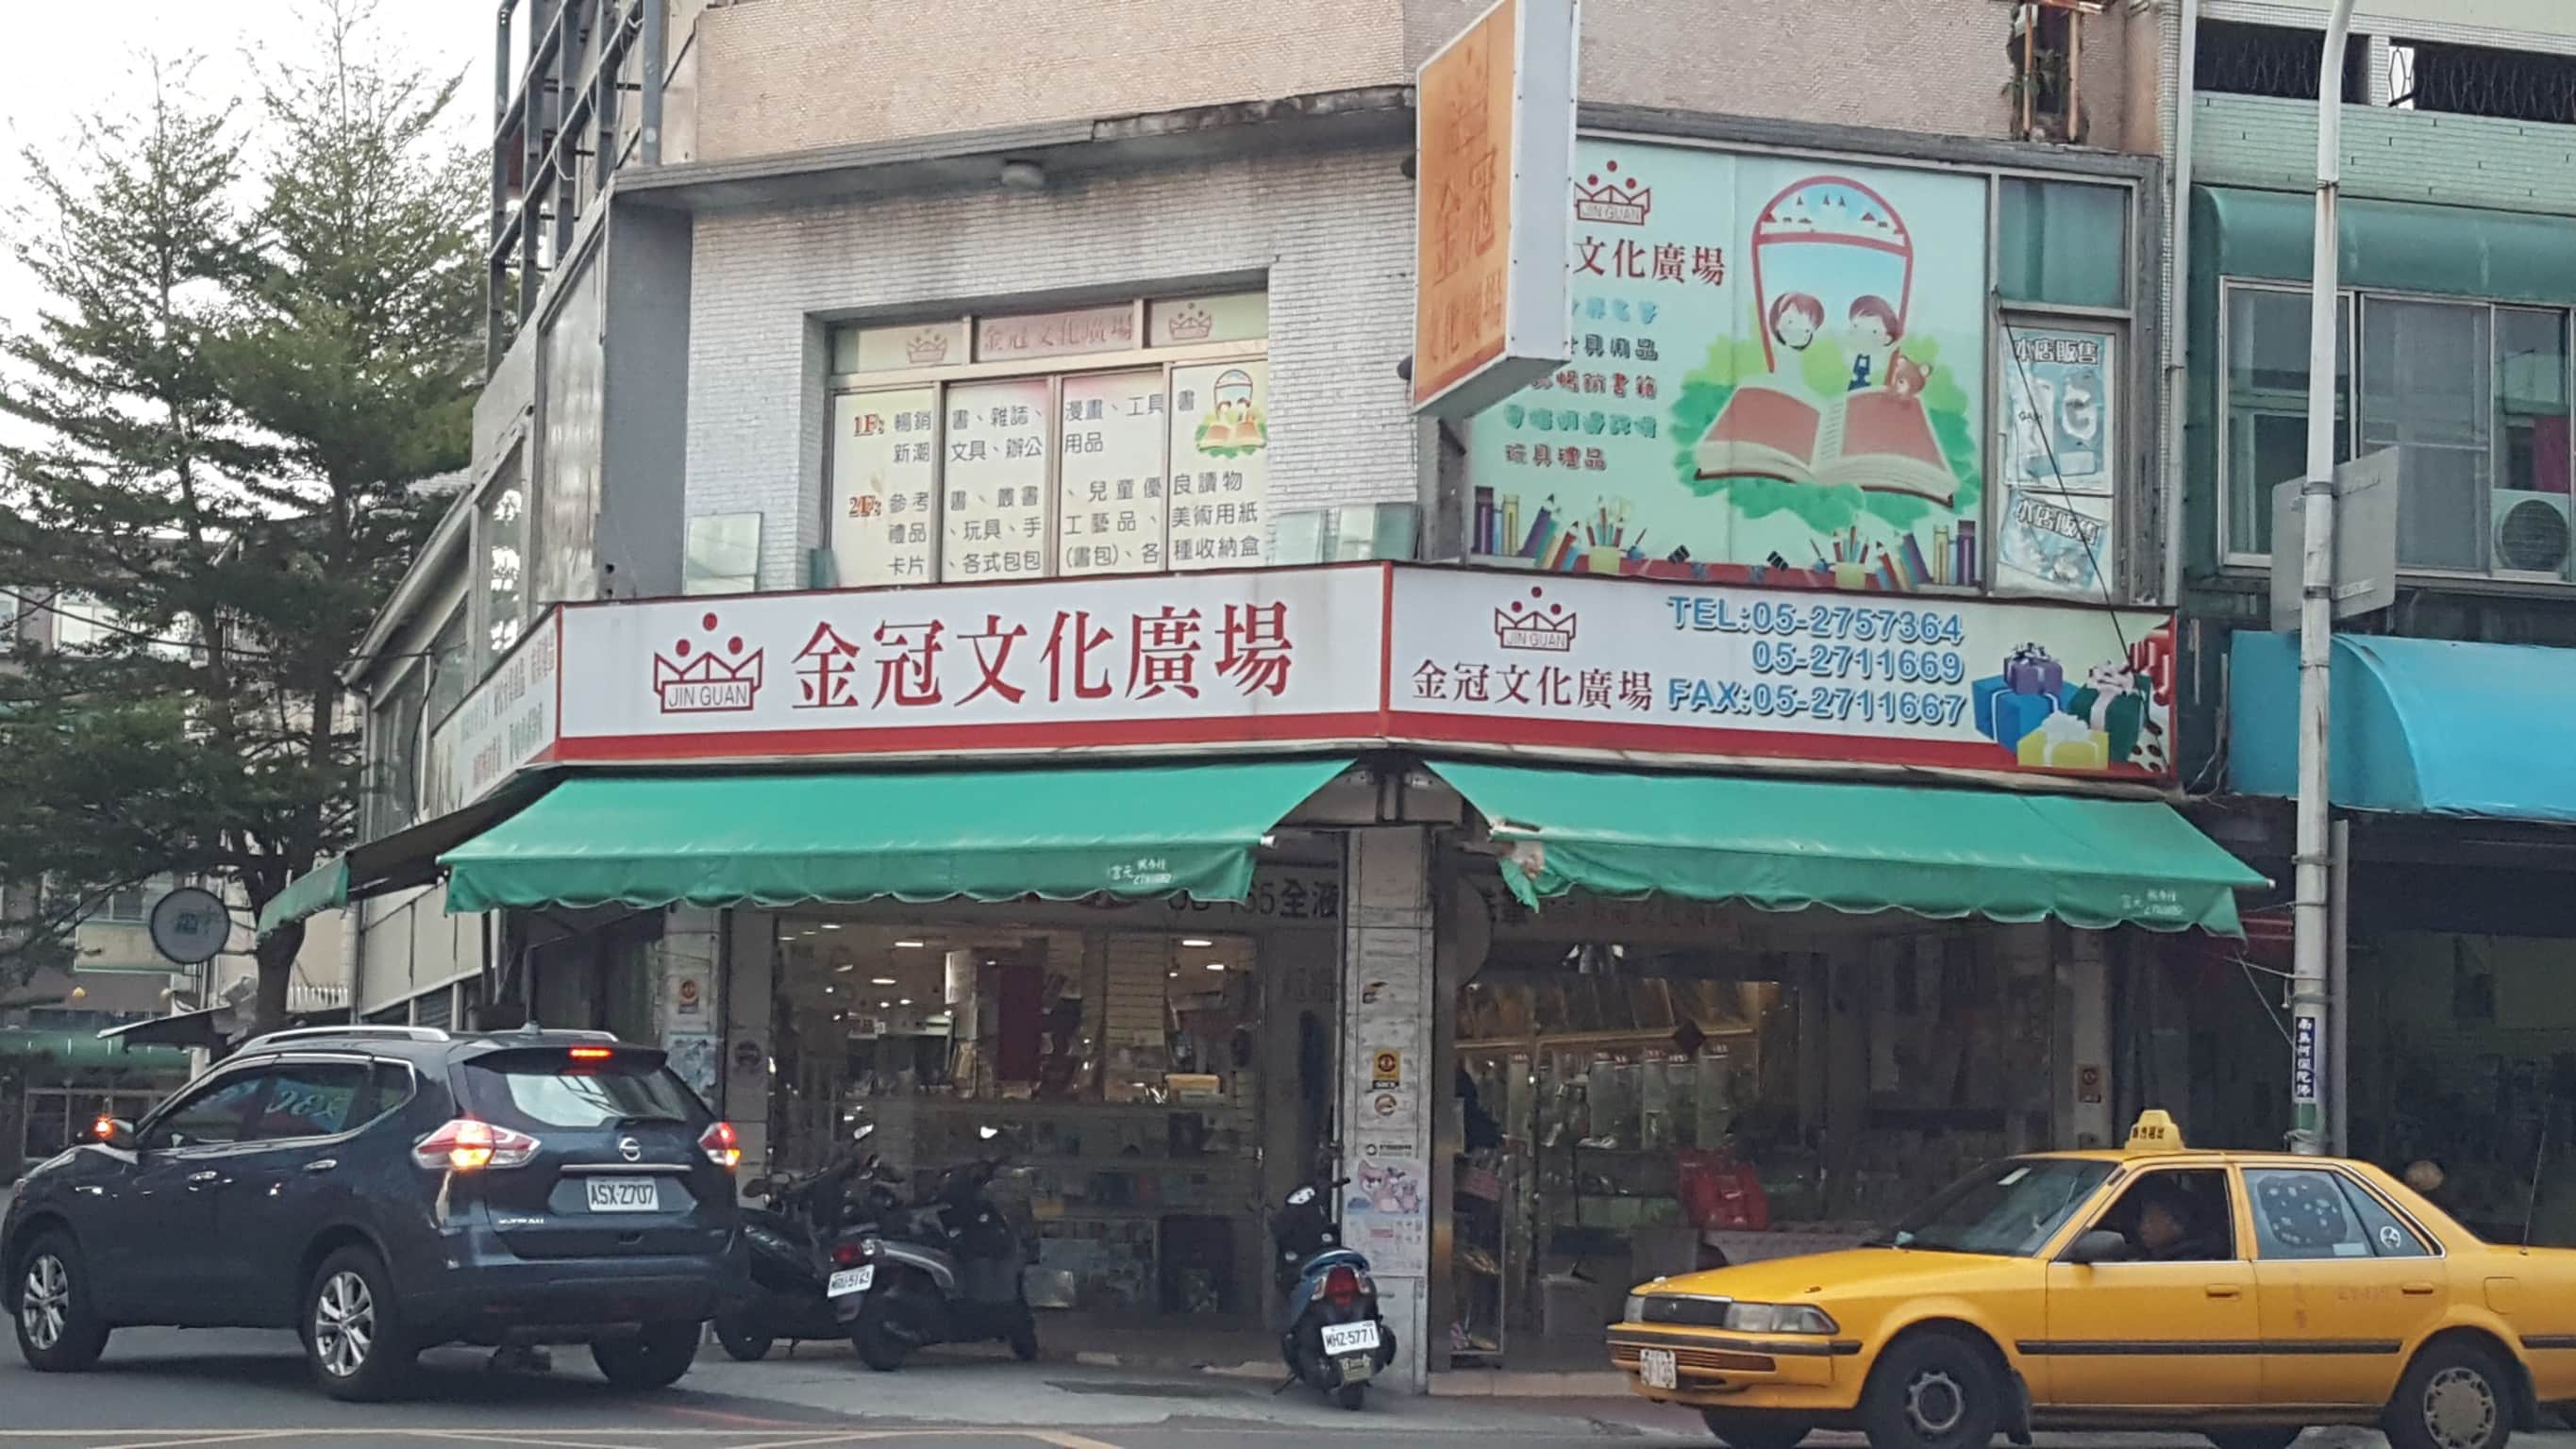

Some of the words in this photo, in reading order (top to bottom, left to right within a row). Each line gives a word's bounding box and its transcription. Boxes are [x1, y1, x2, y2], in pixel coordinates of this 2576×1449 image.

[1572, 236, 1725, 286] 文化廣場
[1506, 631, 1527, 646] JIN
[1530, 633, 1566, 648] GUAN
[1667, 595, 1965, 644] TEL:05-2757364
[790, 599, 1294, 709] 金冠文化廣場
[1751, 640, 1965, 684] 05-2711669
[668, 686, 695, 708] JIN
[699, 684, 748, 706] GUAN
[1413, 658, 1653, 712] 金冠文化廣場
[1667, 677, 1966, 727] FAX:05-2711667
[591, 1184, 654, 1206] ASX-2707
